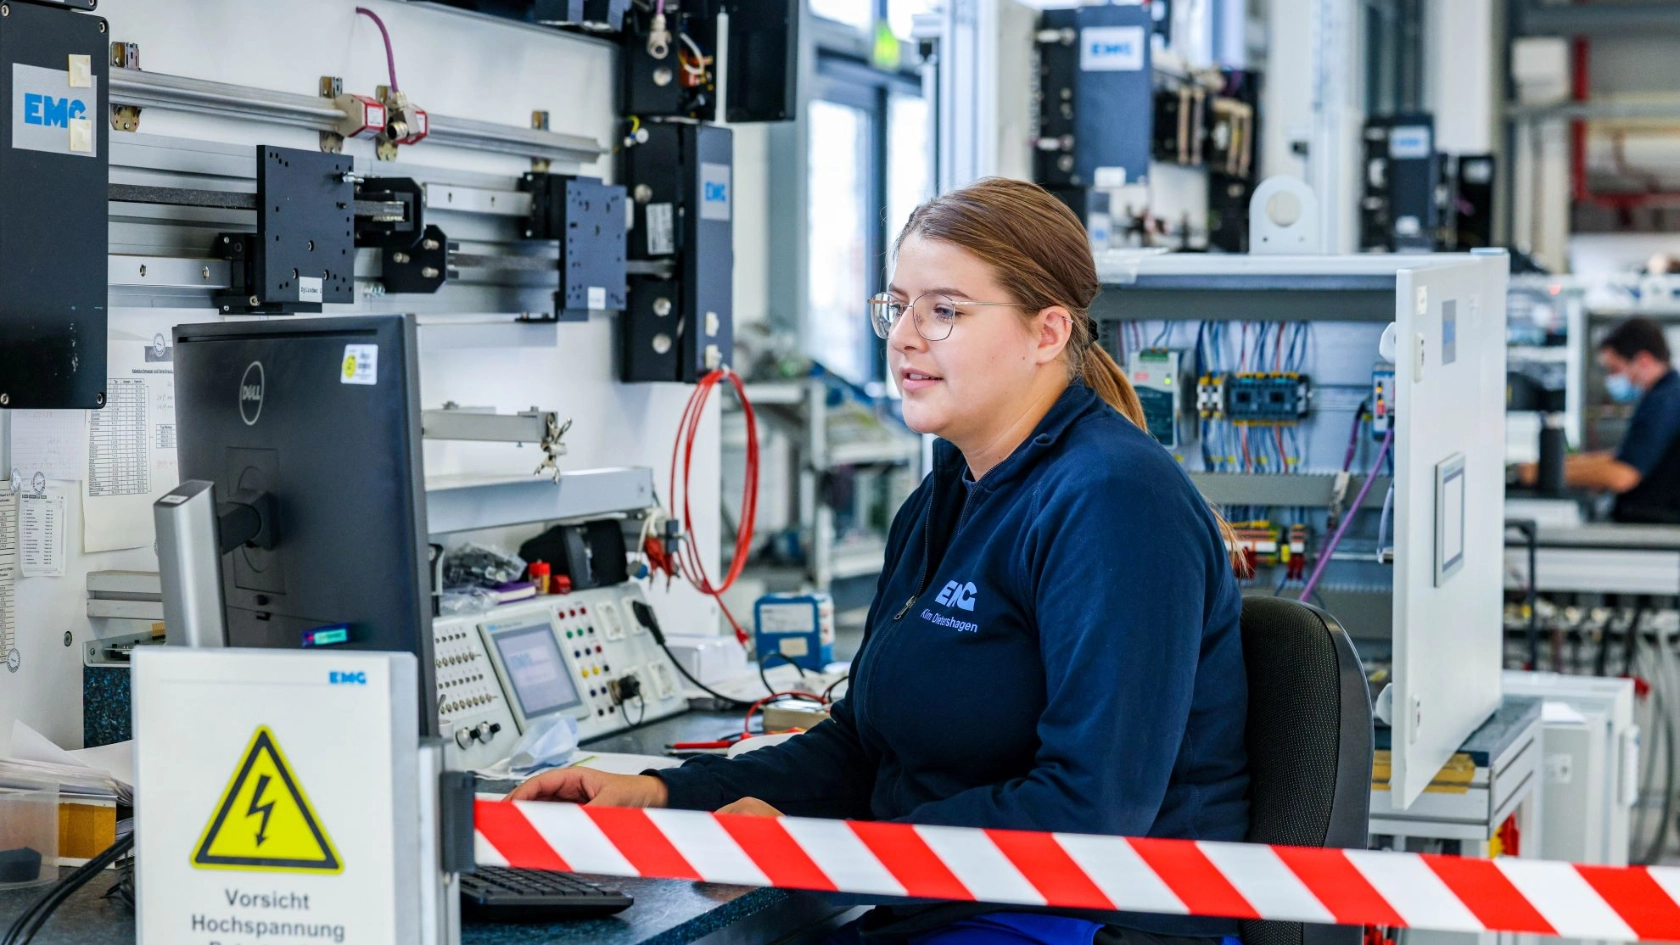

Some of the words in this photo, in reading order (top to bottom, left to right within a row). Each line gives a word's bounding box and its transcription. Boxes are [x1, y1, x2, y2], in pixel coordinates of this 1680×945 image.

[242, 385, 261, 401] DELL
[329, 671, 366, 685] EMG
[225, 888, 309, 910] Vorsicht
[191, 914, 345, 943] Hochspannung
